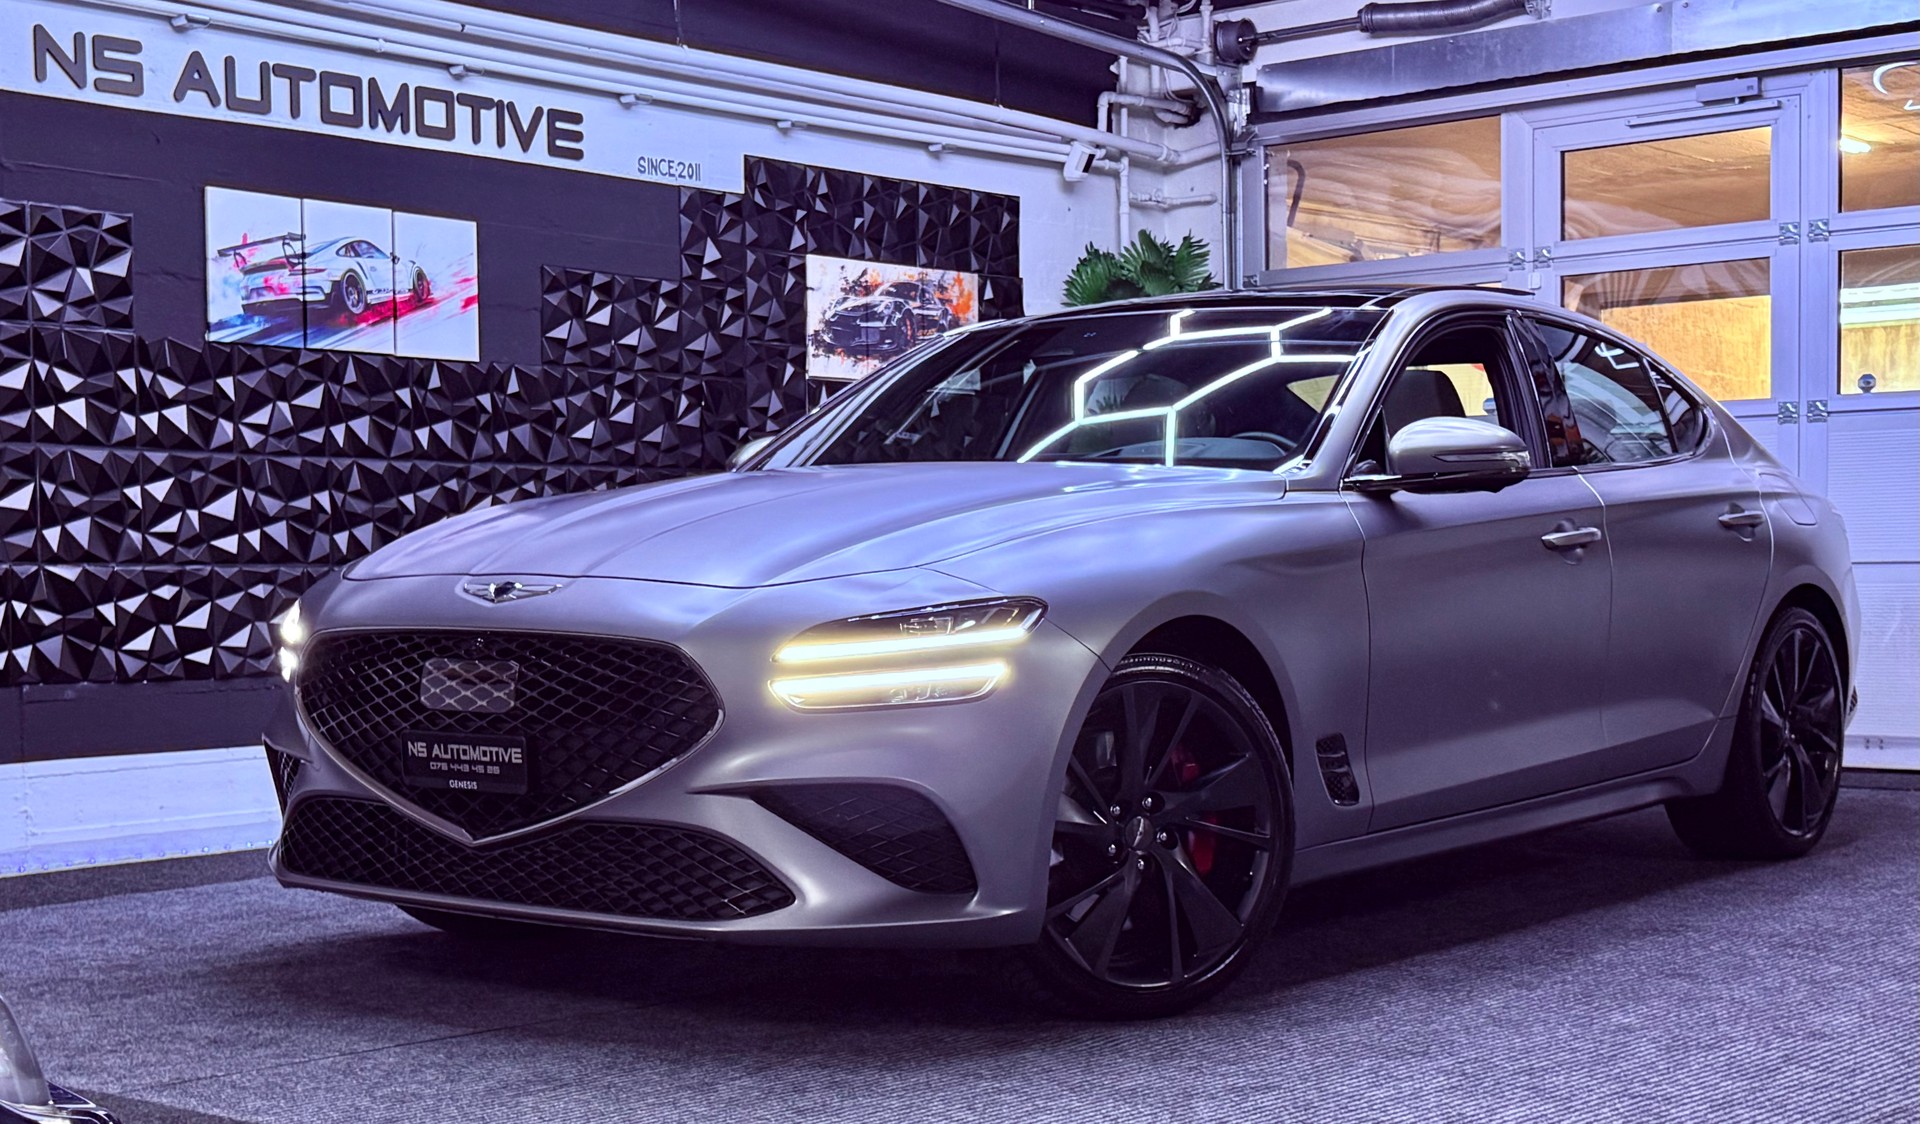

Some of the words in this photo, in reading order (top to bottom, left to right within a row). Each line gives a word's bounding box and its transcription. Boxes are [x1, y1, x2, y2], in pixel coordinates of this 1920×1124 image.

[33, 23, 144, 98] NS
[173, 50, 584, 161] AUTOMOTIVE
[408, 741, 428, 758] NS
[432, 743, 523, 763] AUTOMOTIVE
[450, 763, 470, 772] 443
[449, 779, 478, 790] GENESIS
